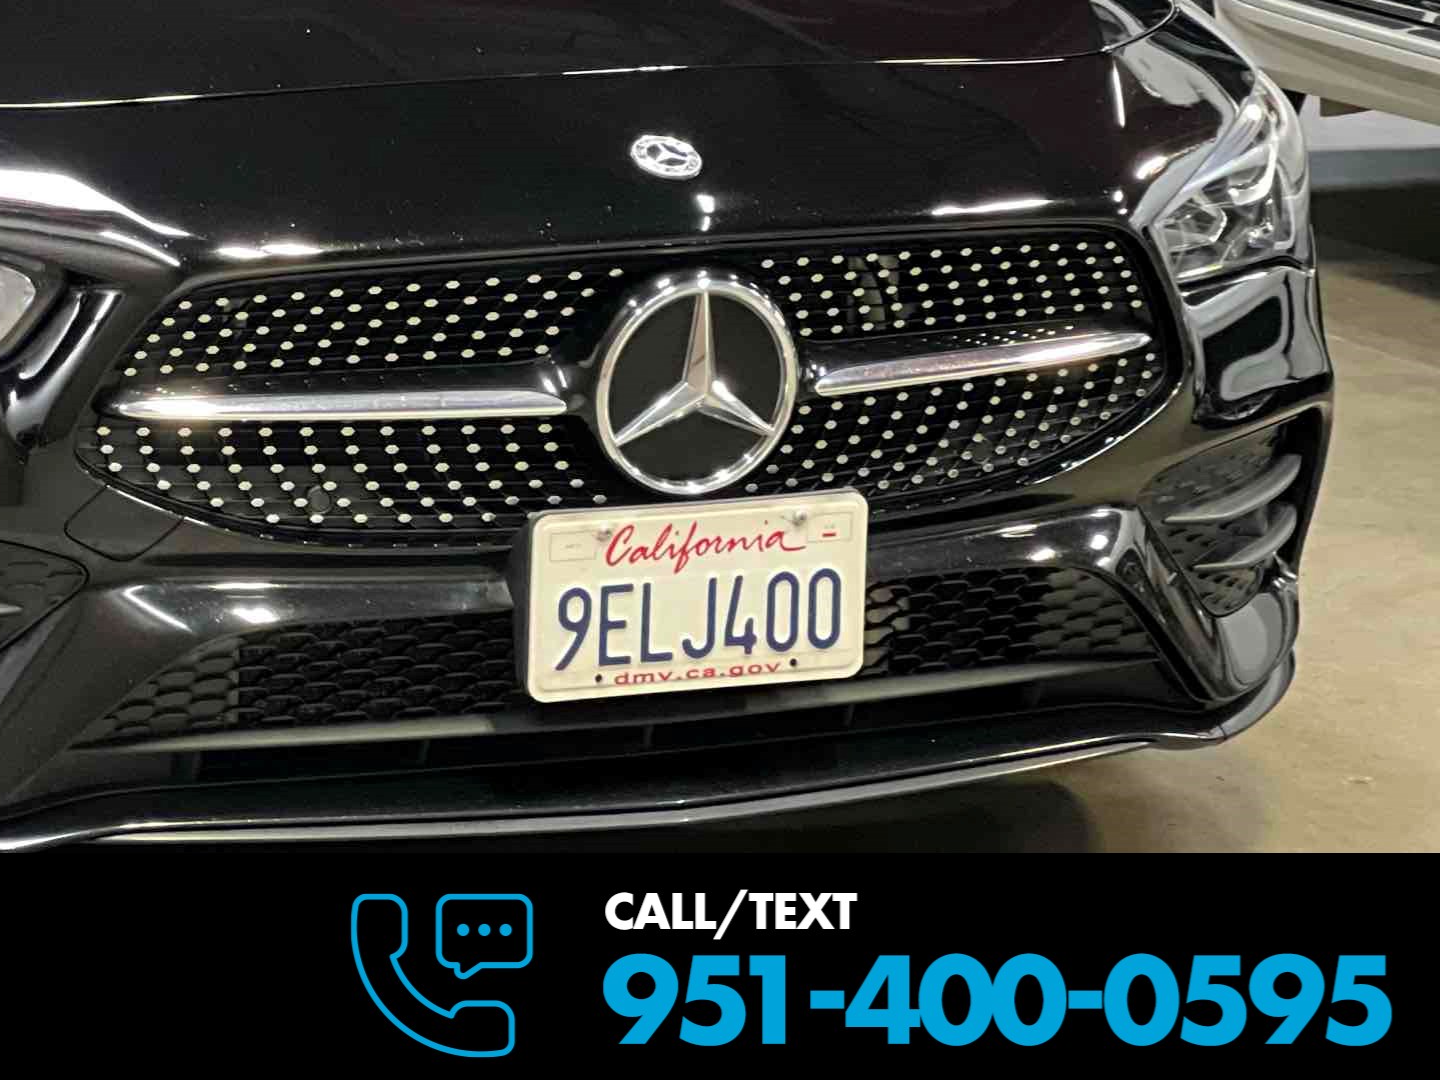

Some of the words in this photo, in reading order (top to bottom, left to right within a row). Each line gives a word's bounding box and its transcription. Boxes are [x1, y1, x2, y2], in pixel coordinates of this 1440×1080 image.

[605, 520, 806, 574] California
[555, 568, 842, 672] 9ELJ400
[614, 662, 781, 686] dmv.ca.gov
